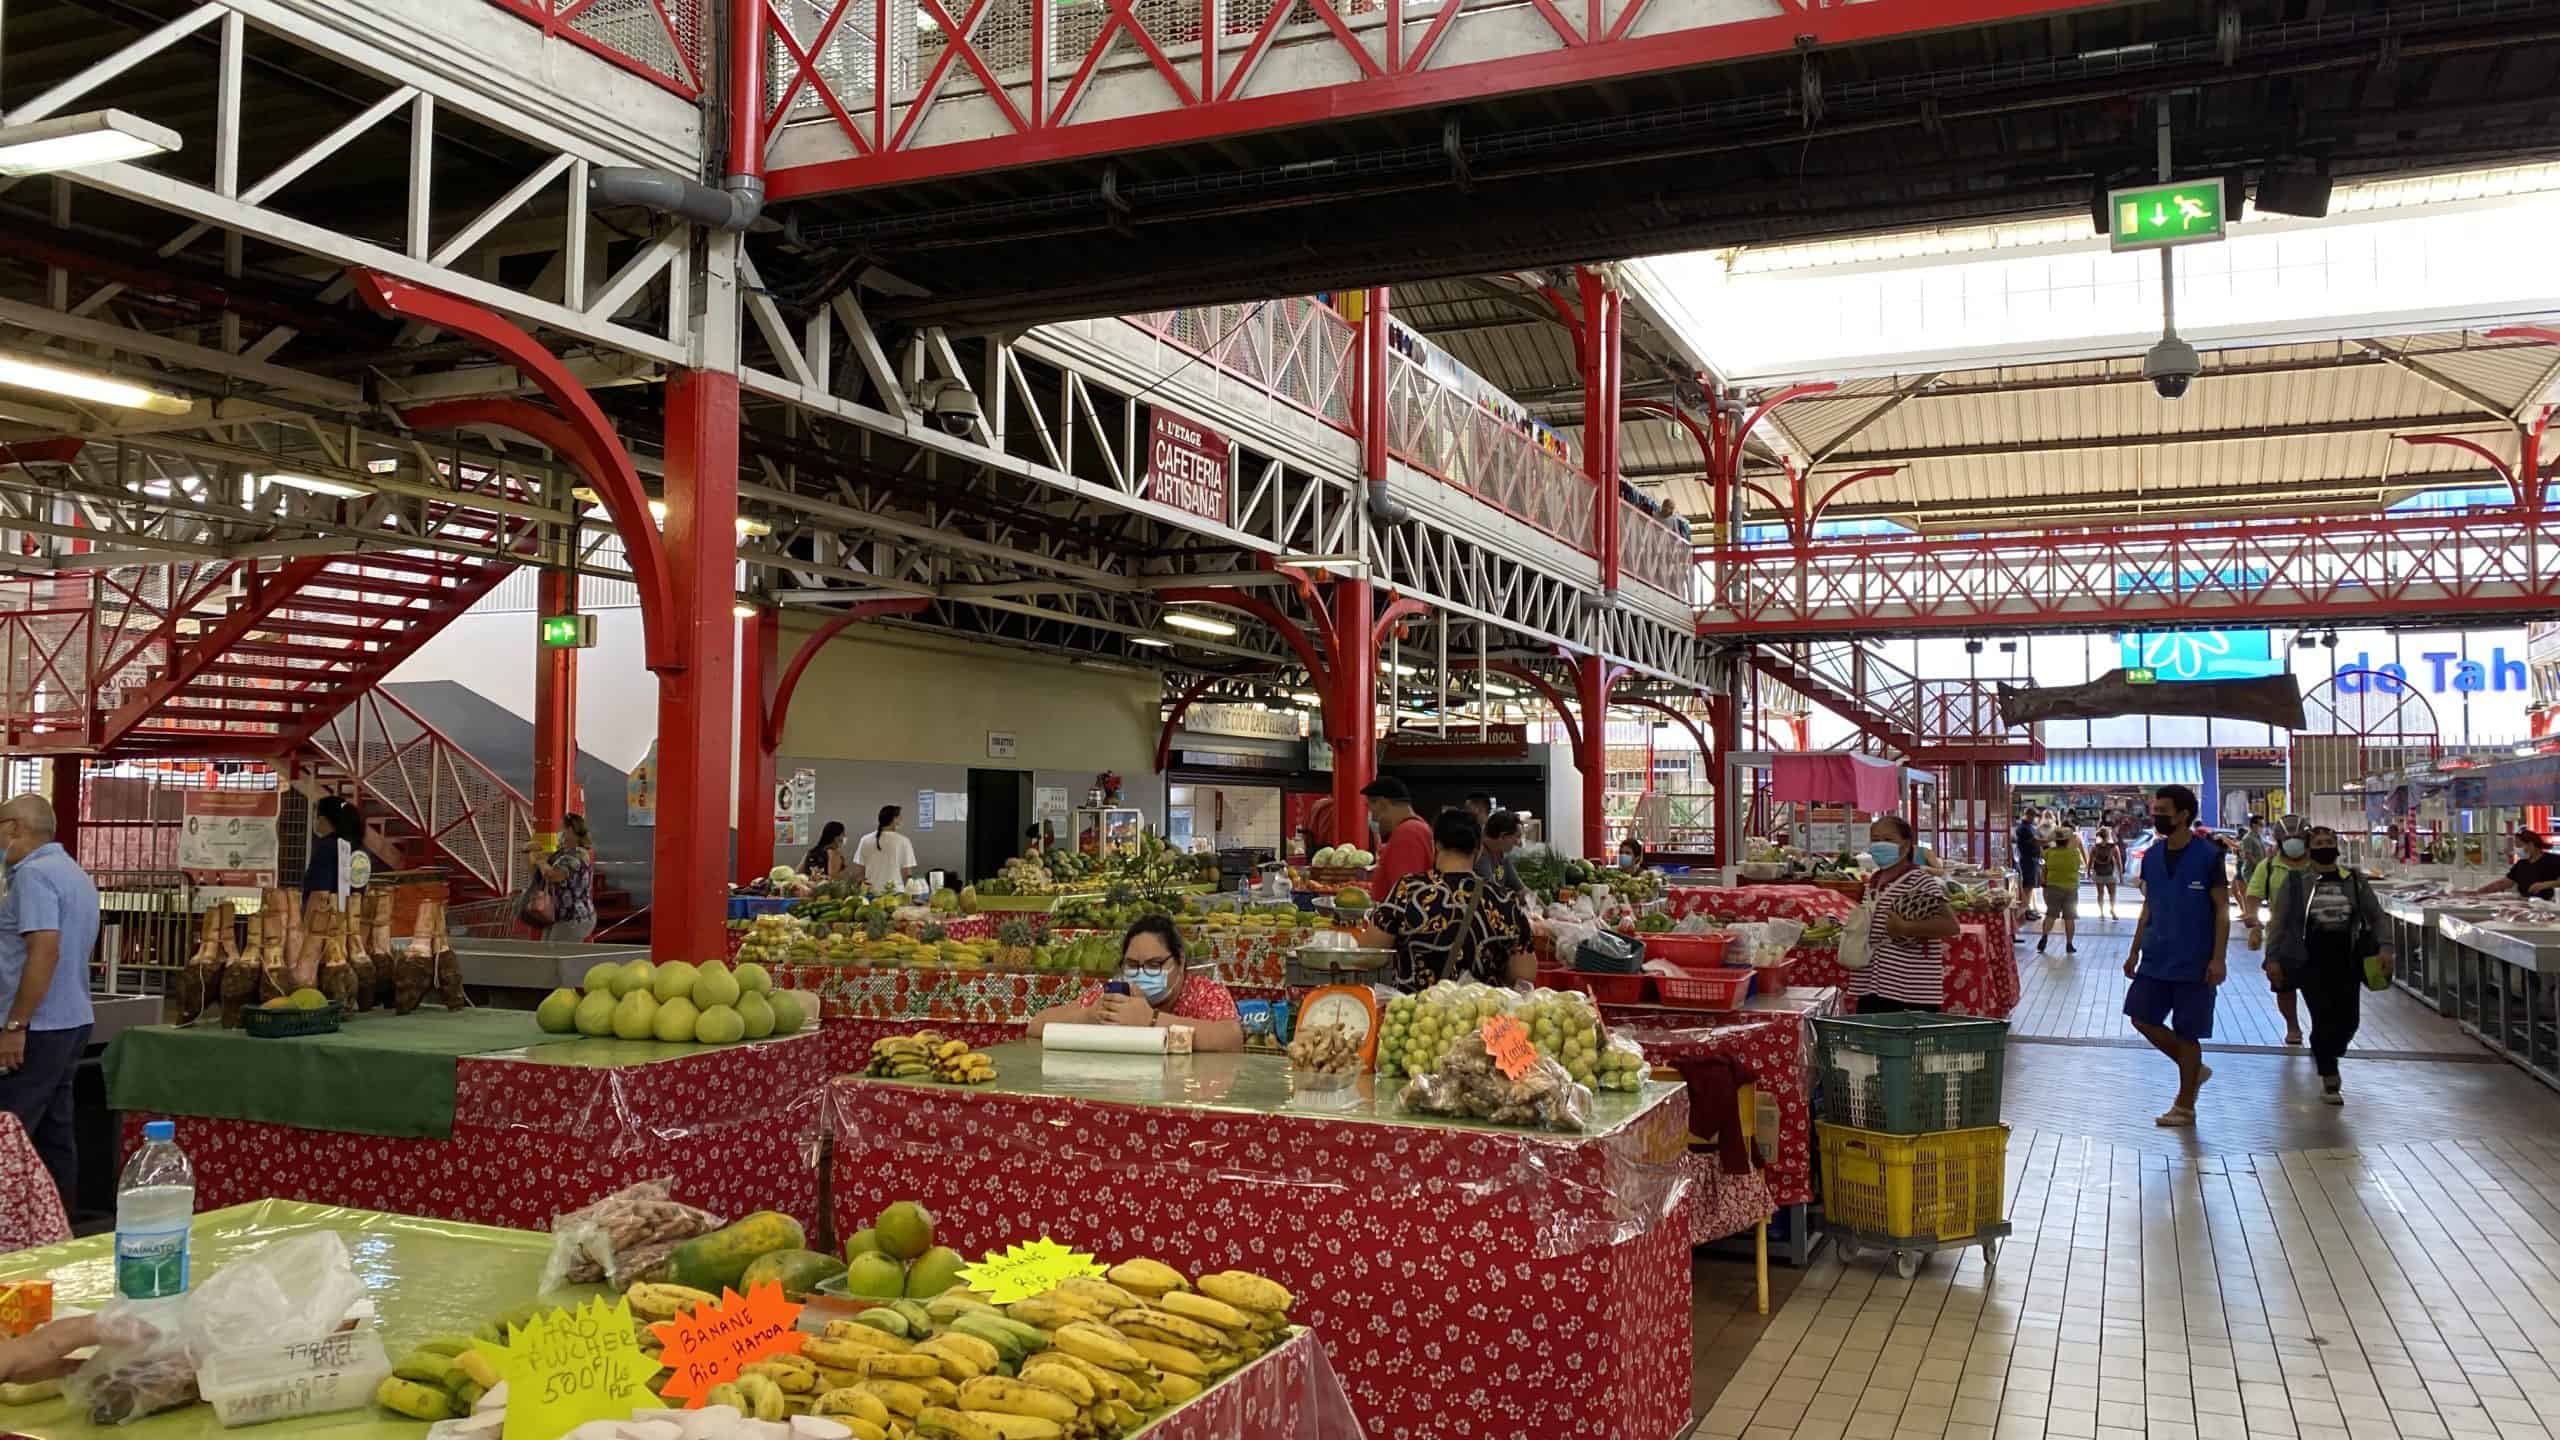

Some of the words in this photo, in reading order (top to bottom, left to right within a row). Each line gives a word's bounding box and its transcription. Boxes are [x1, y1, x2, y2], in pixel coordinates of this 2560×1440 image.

[1157, 417, 1164, 431] A
[1168, 421, 1202, 446] L'ETAGE
[1156, 440, 1222, 491] CAFETERIA
[1155, 471, 1222, 519] ARTISANAT
[2336, 652, 2407, 694] de
[2422, 648, 2527, 693] Tah
[1488, 732, 1515, 744] LOCAL
[680, 1308, 753, 1354] BANANE
